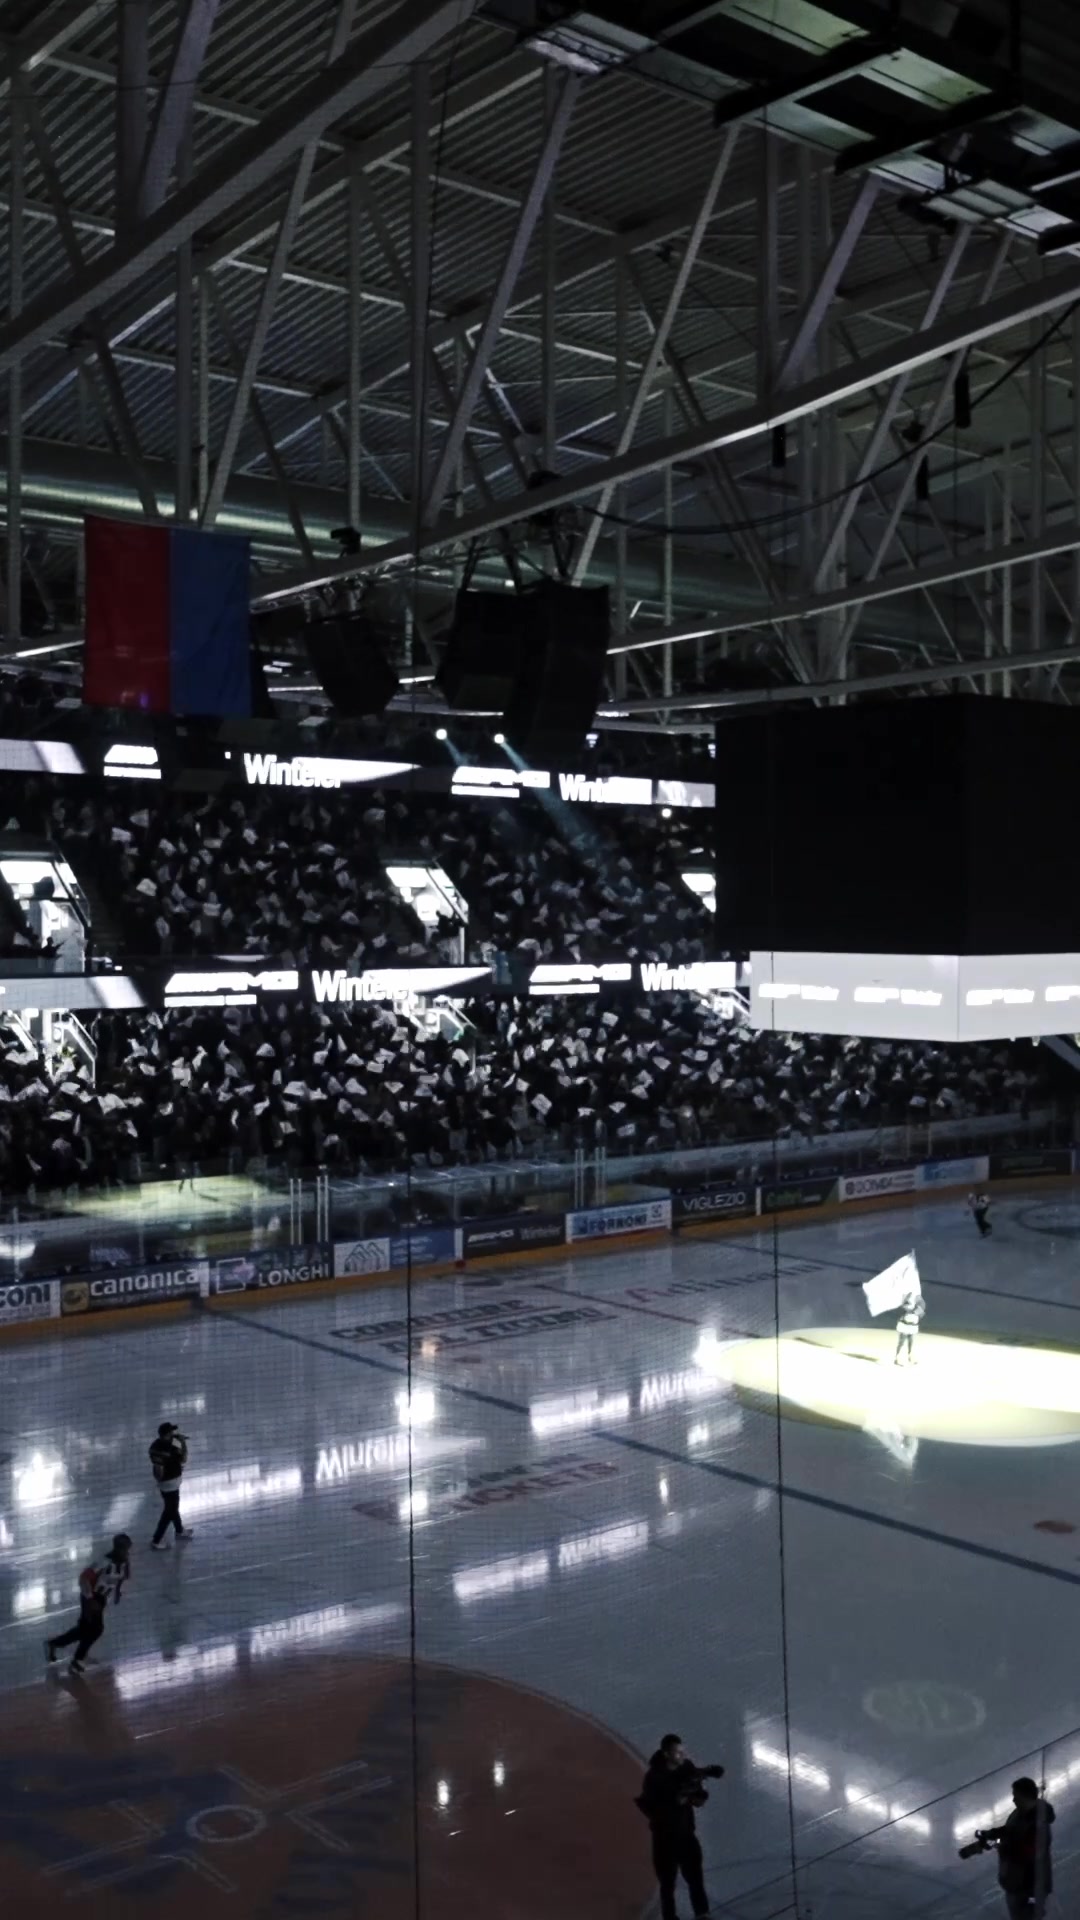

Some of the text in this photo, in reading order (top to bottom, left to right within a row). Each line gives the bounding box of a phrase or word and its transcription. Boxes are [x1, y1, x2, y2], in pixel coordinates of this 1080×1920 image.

[311, 969, 414, 1003] Winte
[90, 1268, 199, 1297] canonica
[258, 1263, 329, 1287] LONGHI
